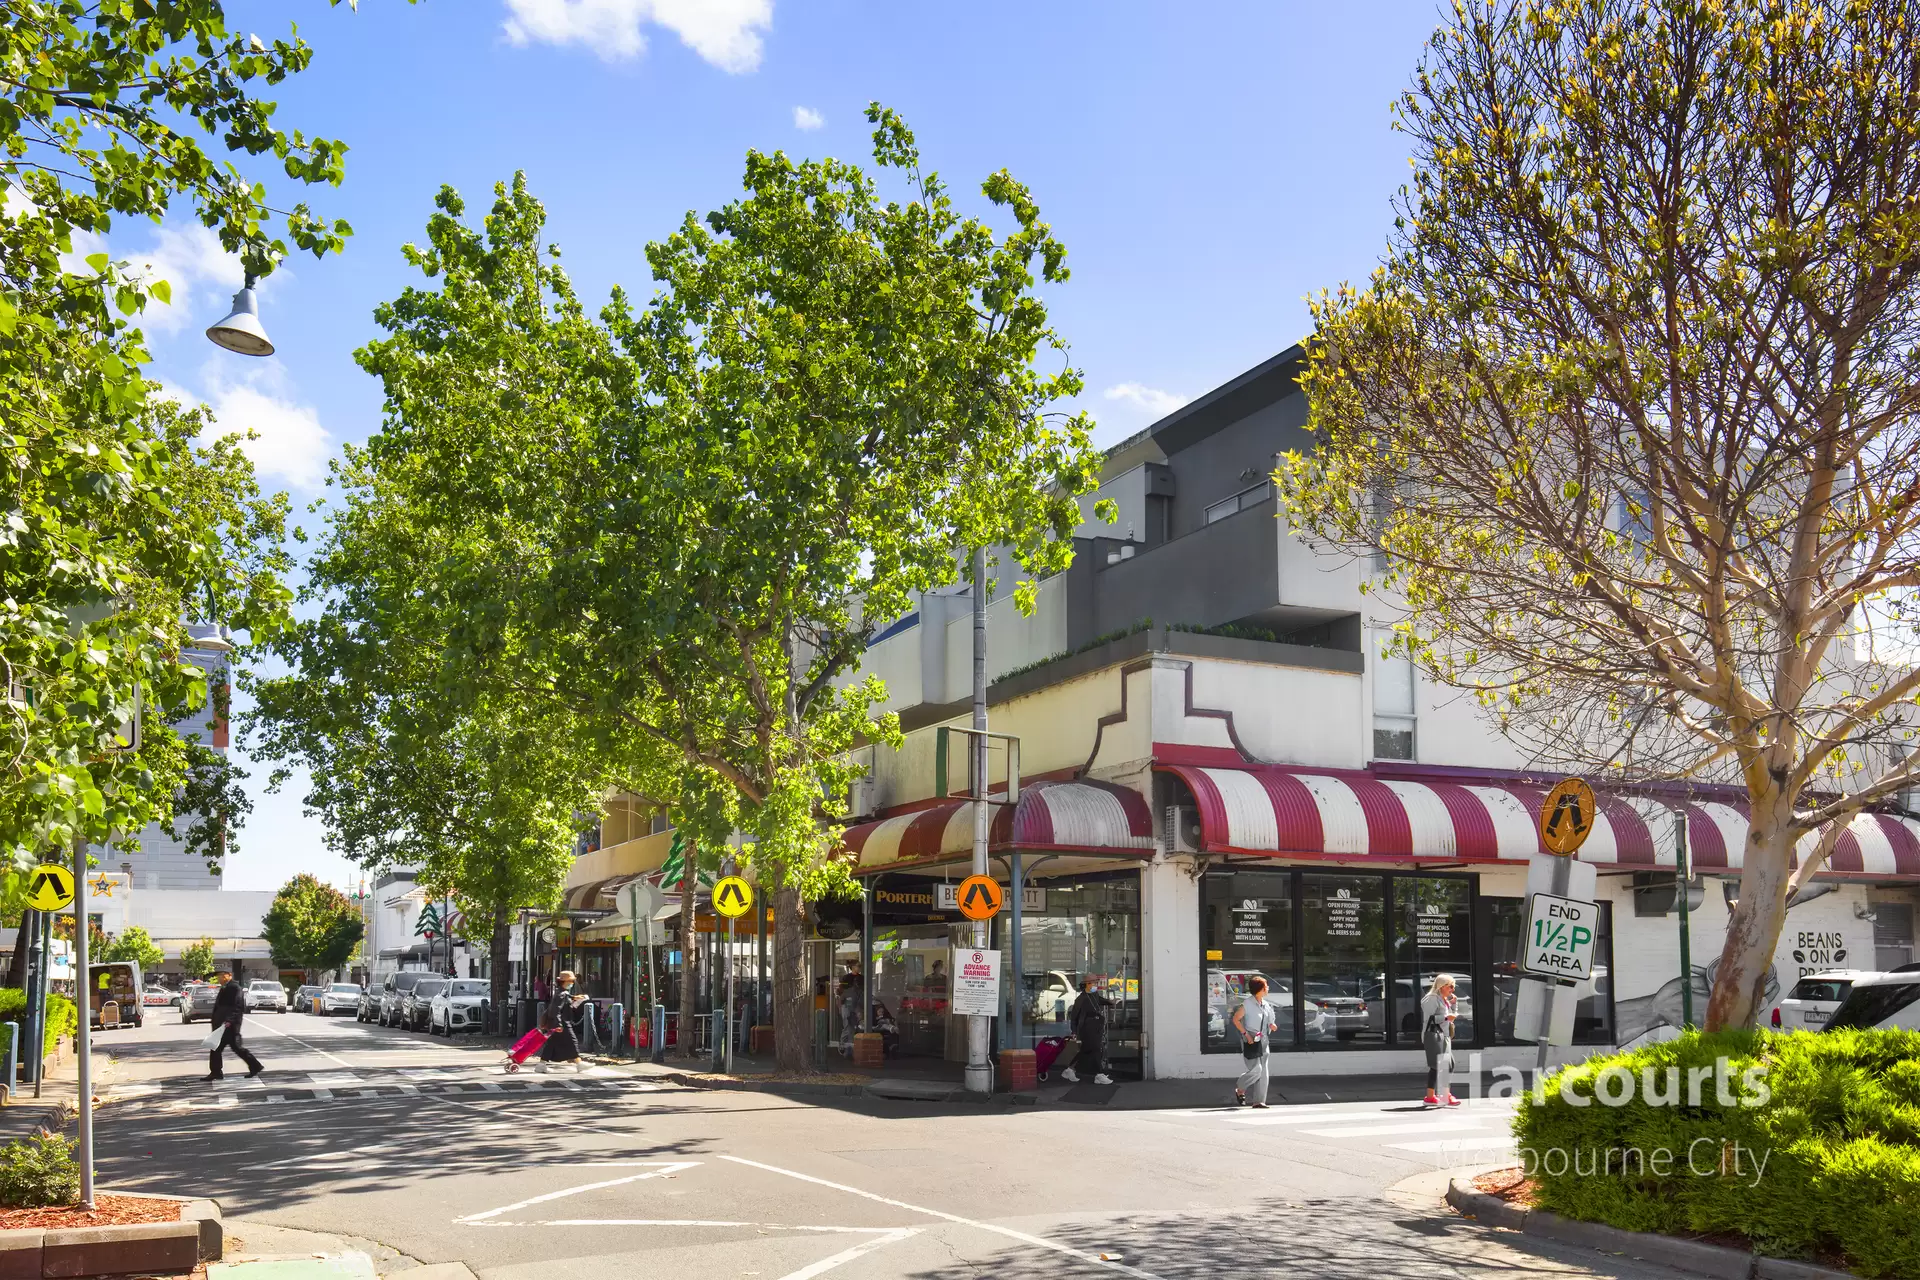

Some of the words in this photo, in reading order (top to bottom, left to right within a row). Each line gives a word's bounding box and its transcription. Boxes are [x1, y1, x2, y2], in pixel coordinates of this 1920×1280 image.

[876, 890, 934, 905] PORTERH
[1004, 889, 1039, 903] PTT
[1549, 904, 1581, 921] END
[1798, 931, 1843, 949] BEANS
[1537, 952, 1583, 972] AREA
[1810, 949, 1829, 964] ON
